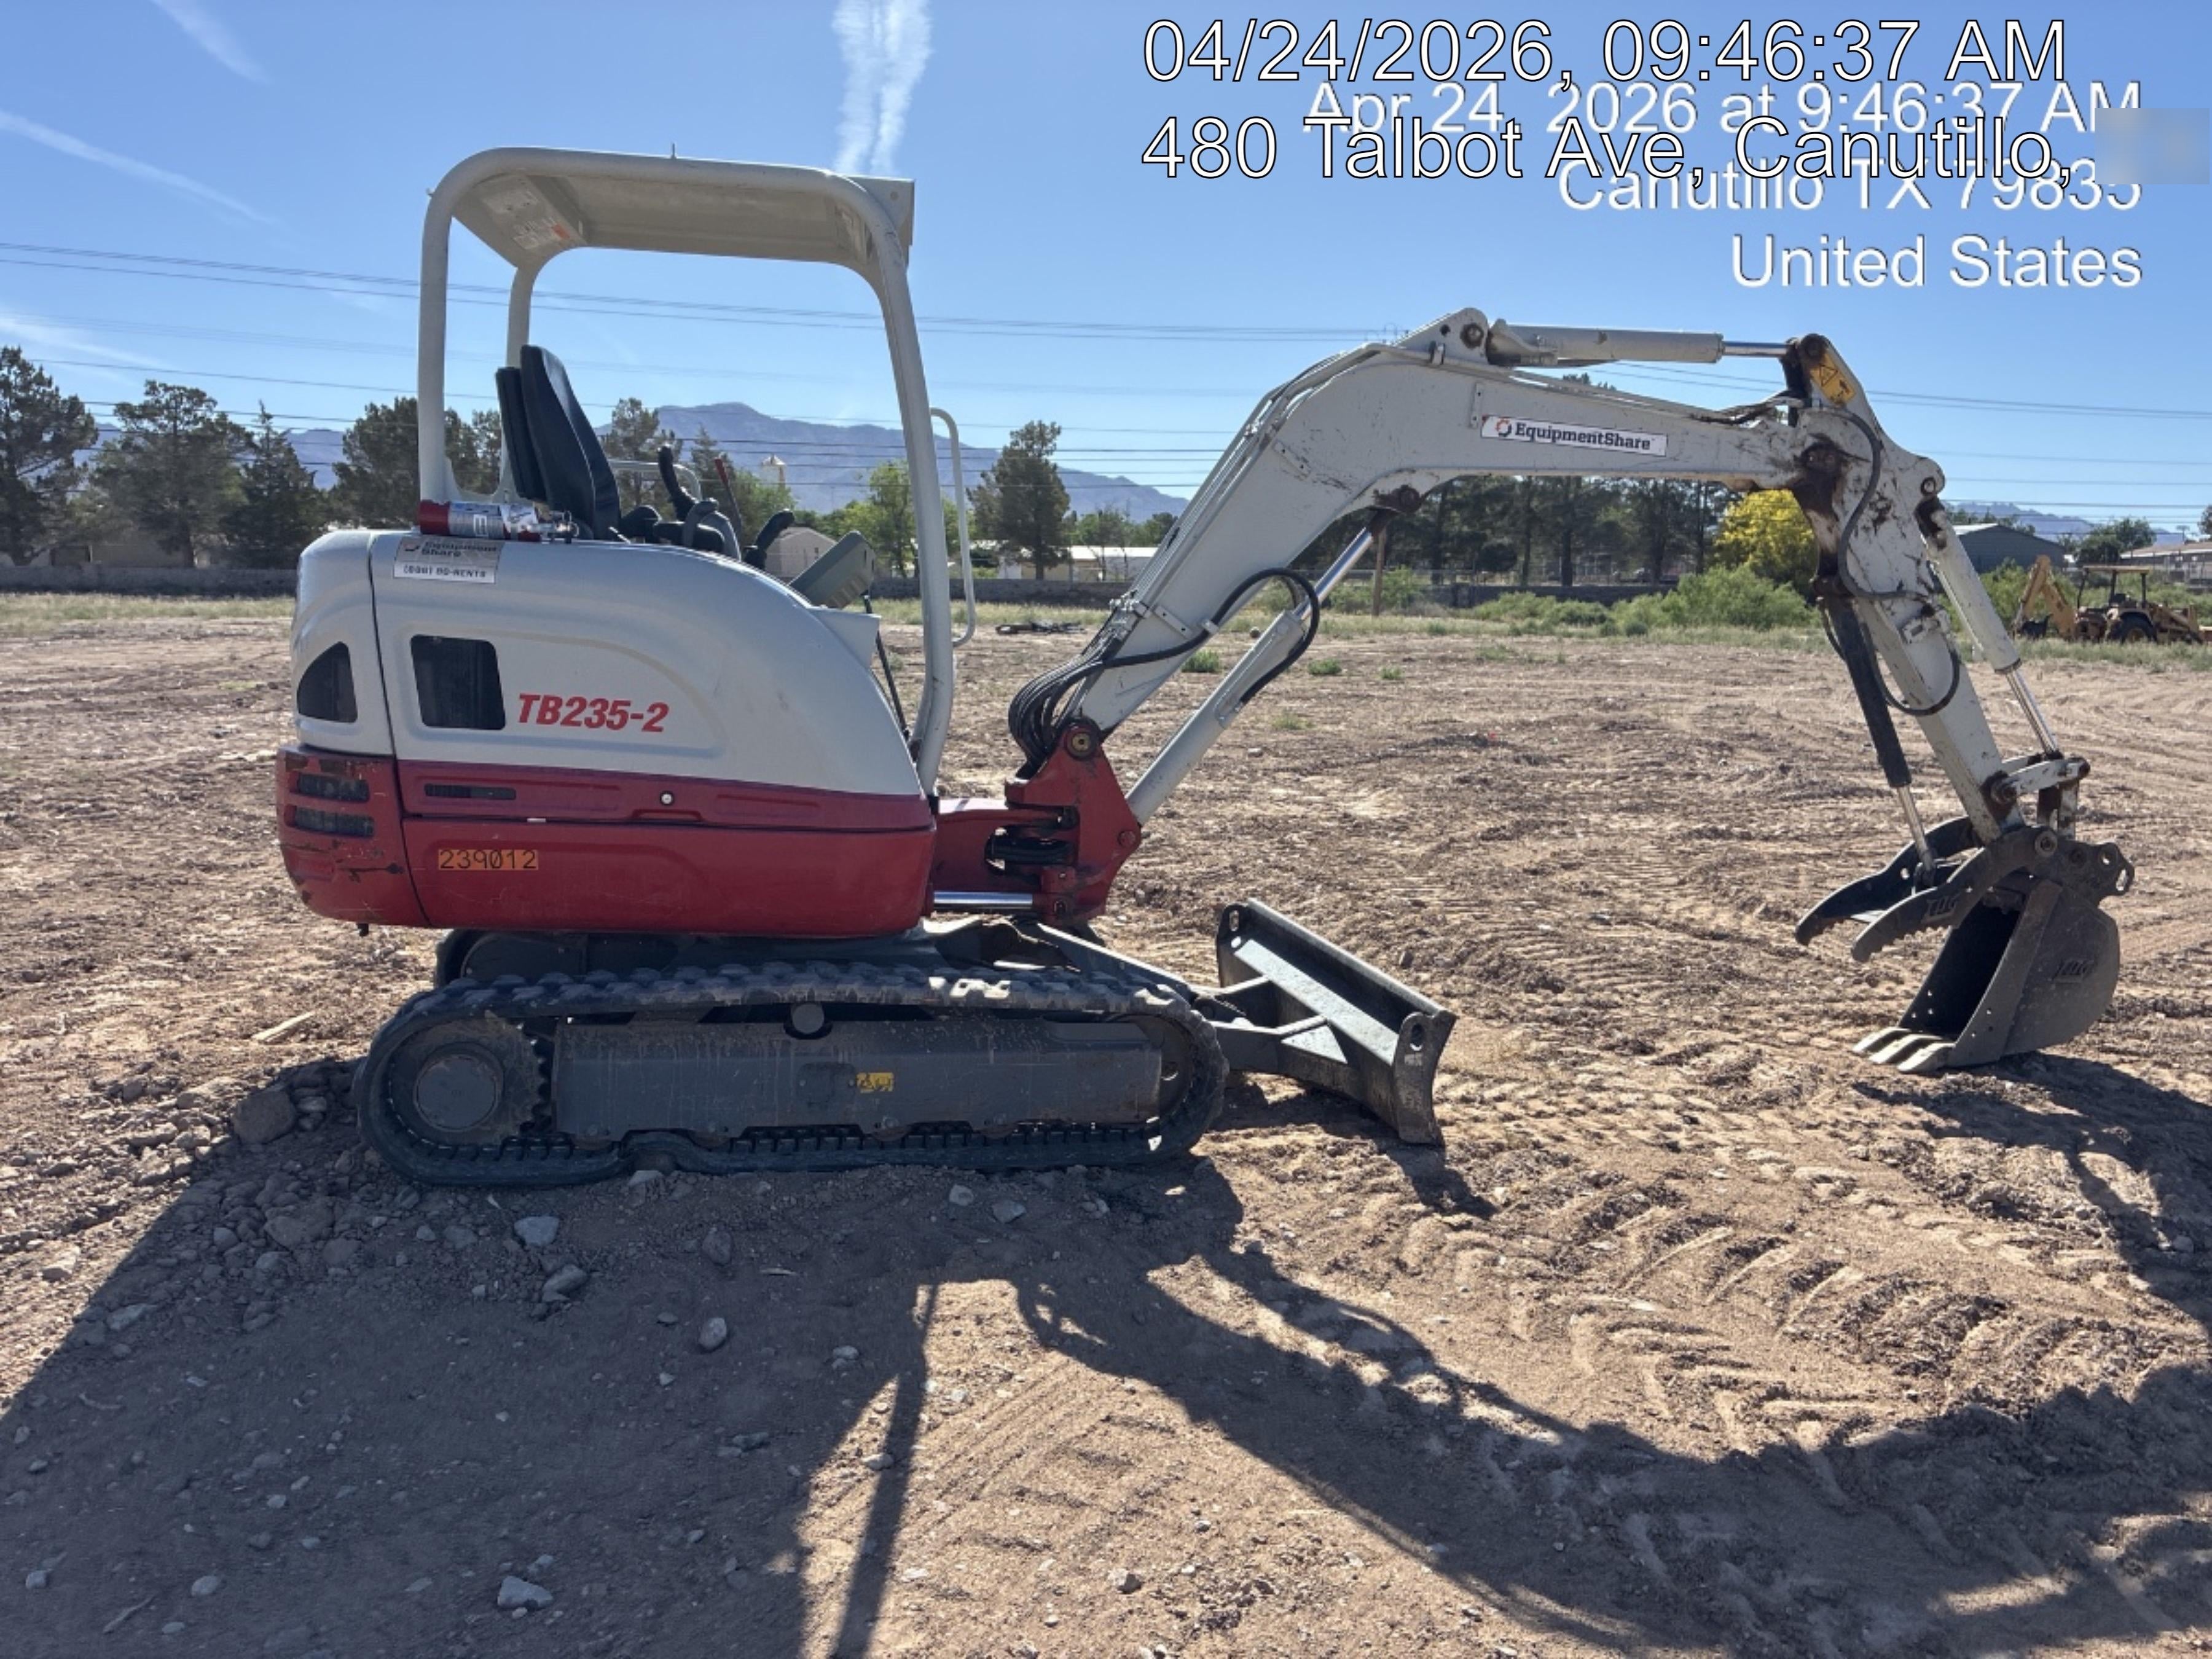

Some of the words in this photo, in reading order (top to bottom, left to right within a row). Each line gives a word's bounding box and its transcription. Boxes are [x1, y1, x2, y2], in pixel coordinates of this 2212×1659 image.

[1515, 422, 1650, 450] EquipmentShare
[519, 692, 670, 732] TB235-2
[440, 849, 536, 869] 239012
